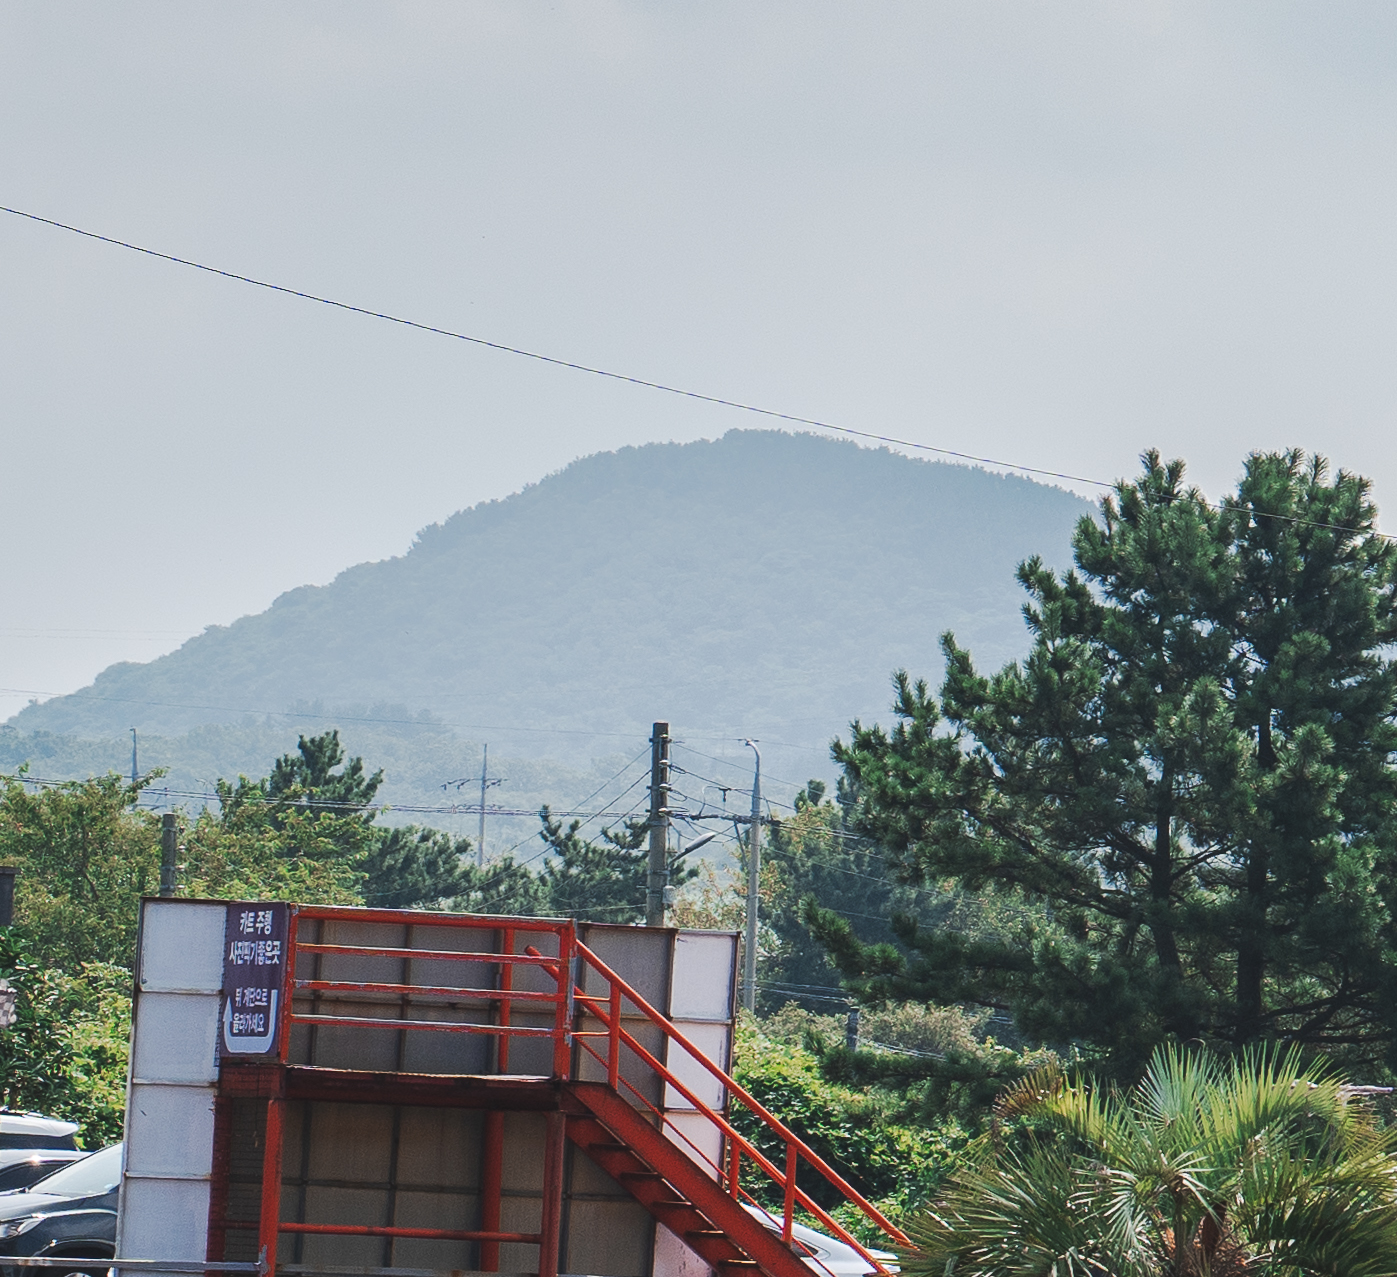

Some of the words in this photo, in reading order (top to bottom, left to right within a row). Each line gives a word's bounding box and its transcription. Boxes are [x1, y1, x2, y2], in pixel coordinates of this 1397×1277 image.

[239, 910, 255, 935] 카트
[256, 910, 274, 935] 주행
[235, 986, 243, 1008] 뒤
[243, 986, 268, 1008] 계단으로
[232, 1012, 265, 1034] 올라가세요
